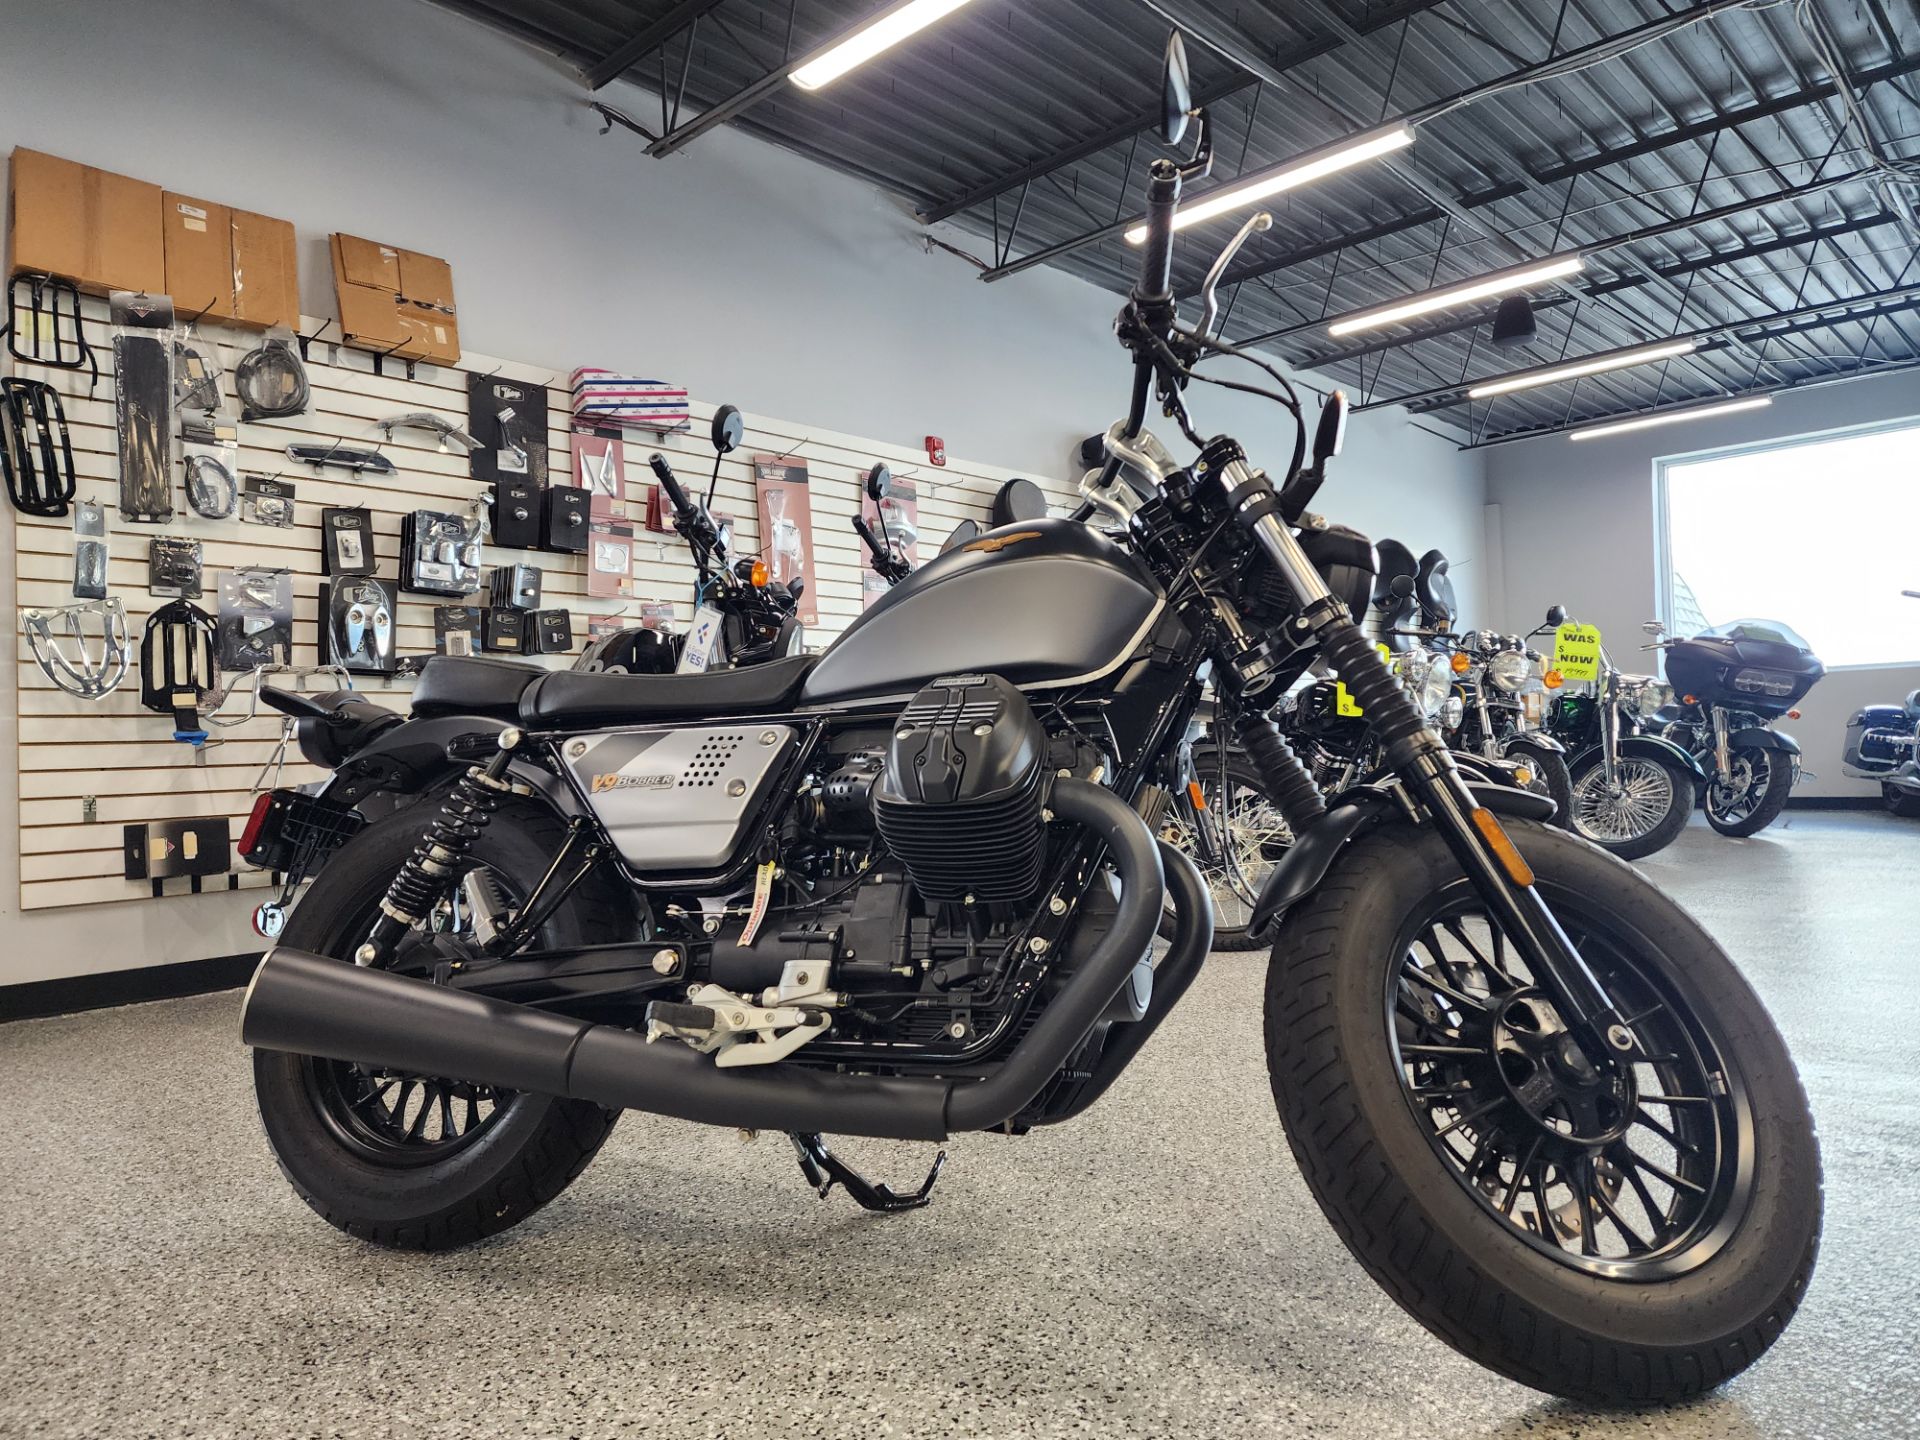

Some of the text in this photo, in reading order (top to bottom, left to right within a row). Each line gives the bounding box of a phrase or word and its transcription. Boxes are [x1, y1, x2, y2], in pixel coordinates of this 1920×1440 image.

[1563, 633, 1596, 643] WAS
[686, 650, 705, 668] YES!
[1560, 654, 1595, 665] NOW
[591, 774, 674, 793] V9 BOBBER
